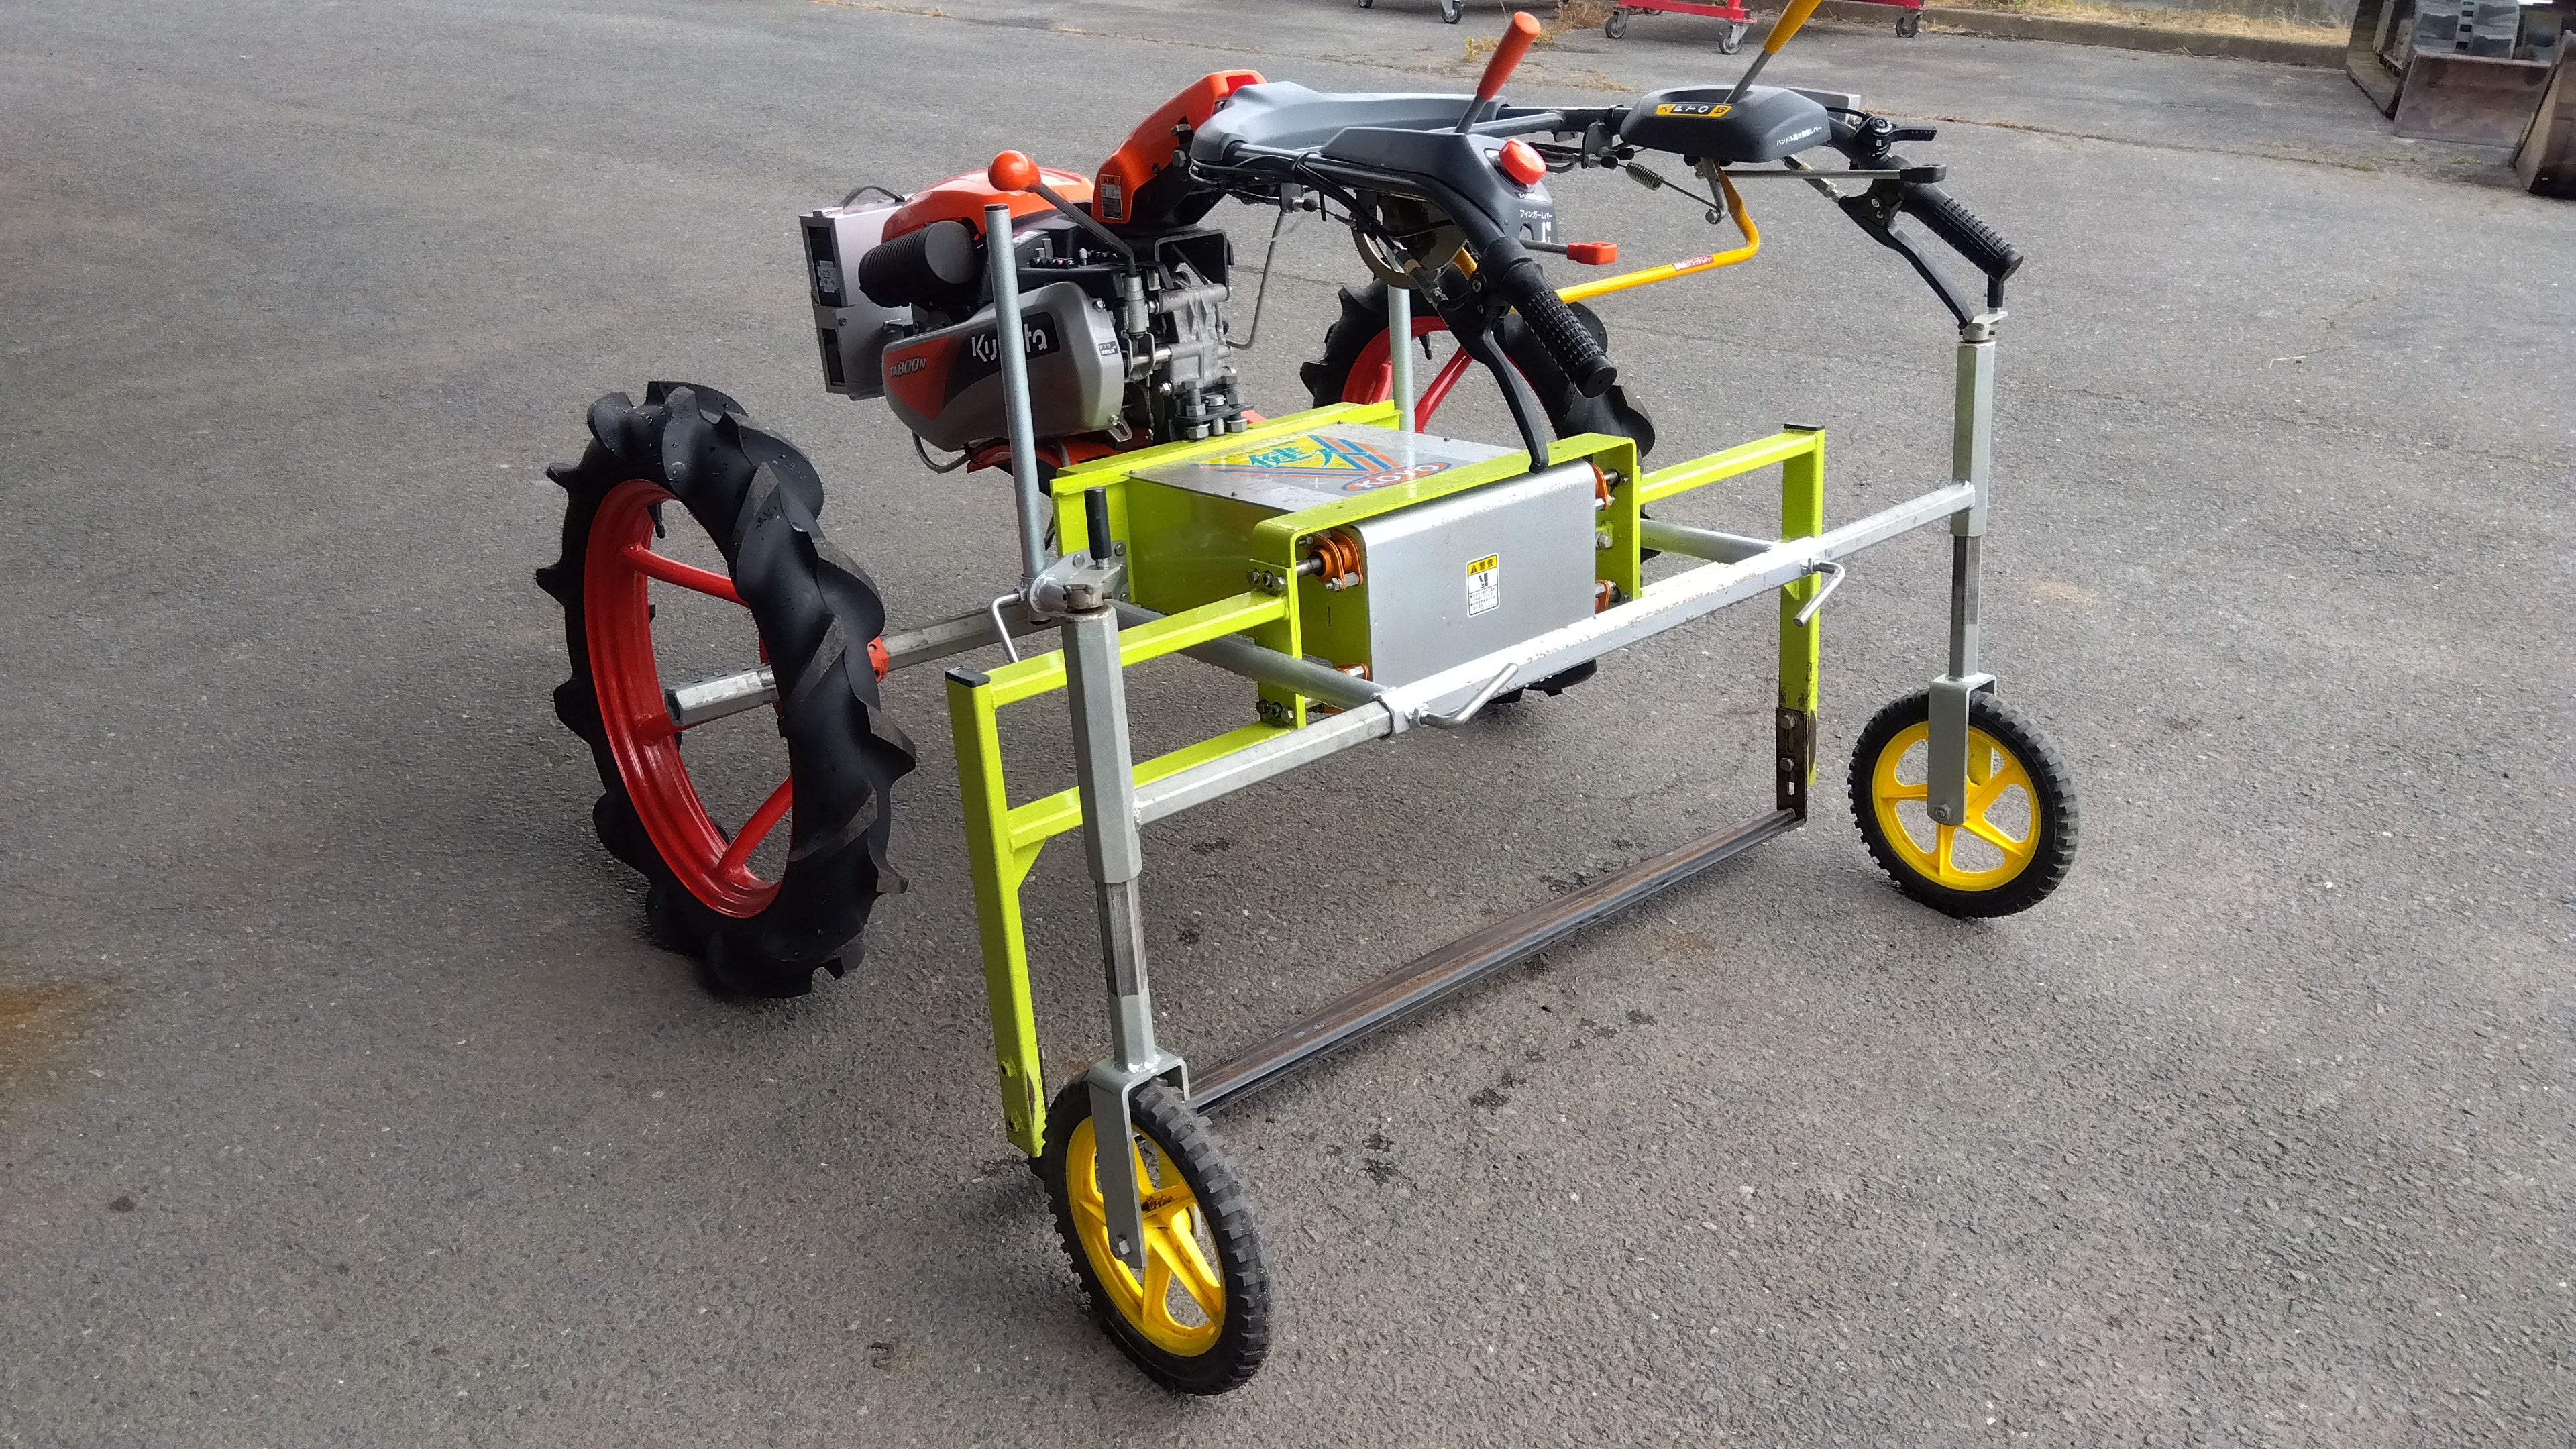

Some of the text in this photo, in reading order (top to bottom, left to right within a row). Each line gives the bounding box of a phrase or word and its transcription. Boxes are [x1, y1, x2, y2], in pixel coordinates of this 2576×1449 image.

[1674, 105, 1709, 113] PTO
[1519, 209, 1553, 220] フィンガーレバー
[971, 323, 1048, 362] Kuta
[889, 357, 927, 378] TA800N
[1353, 464, 1440, 488] KOYO
